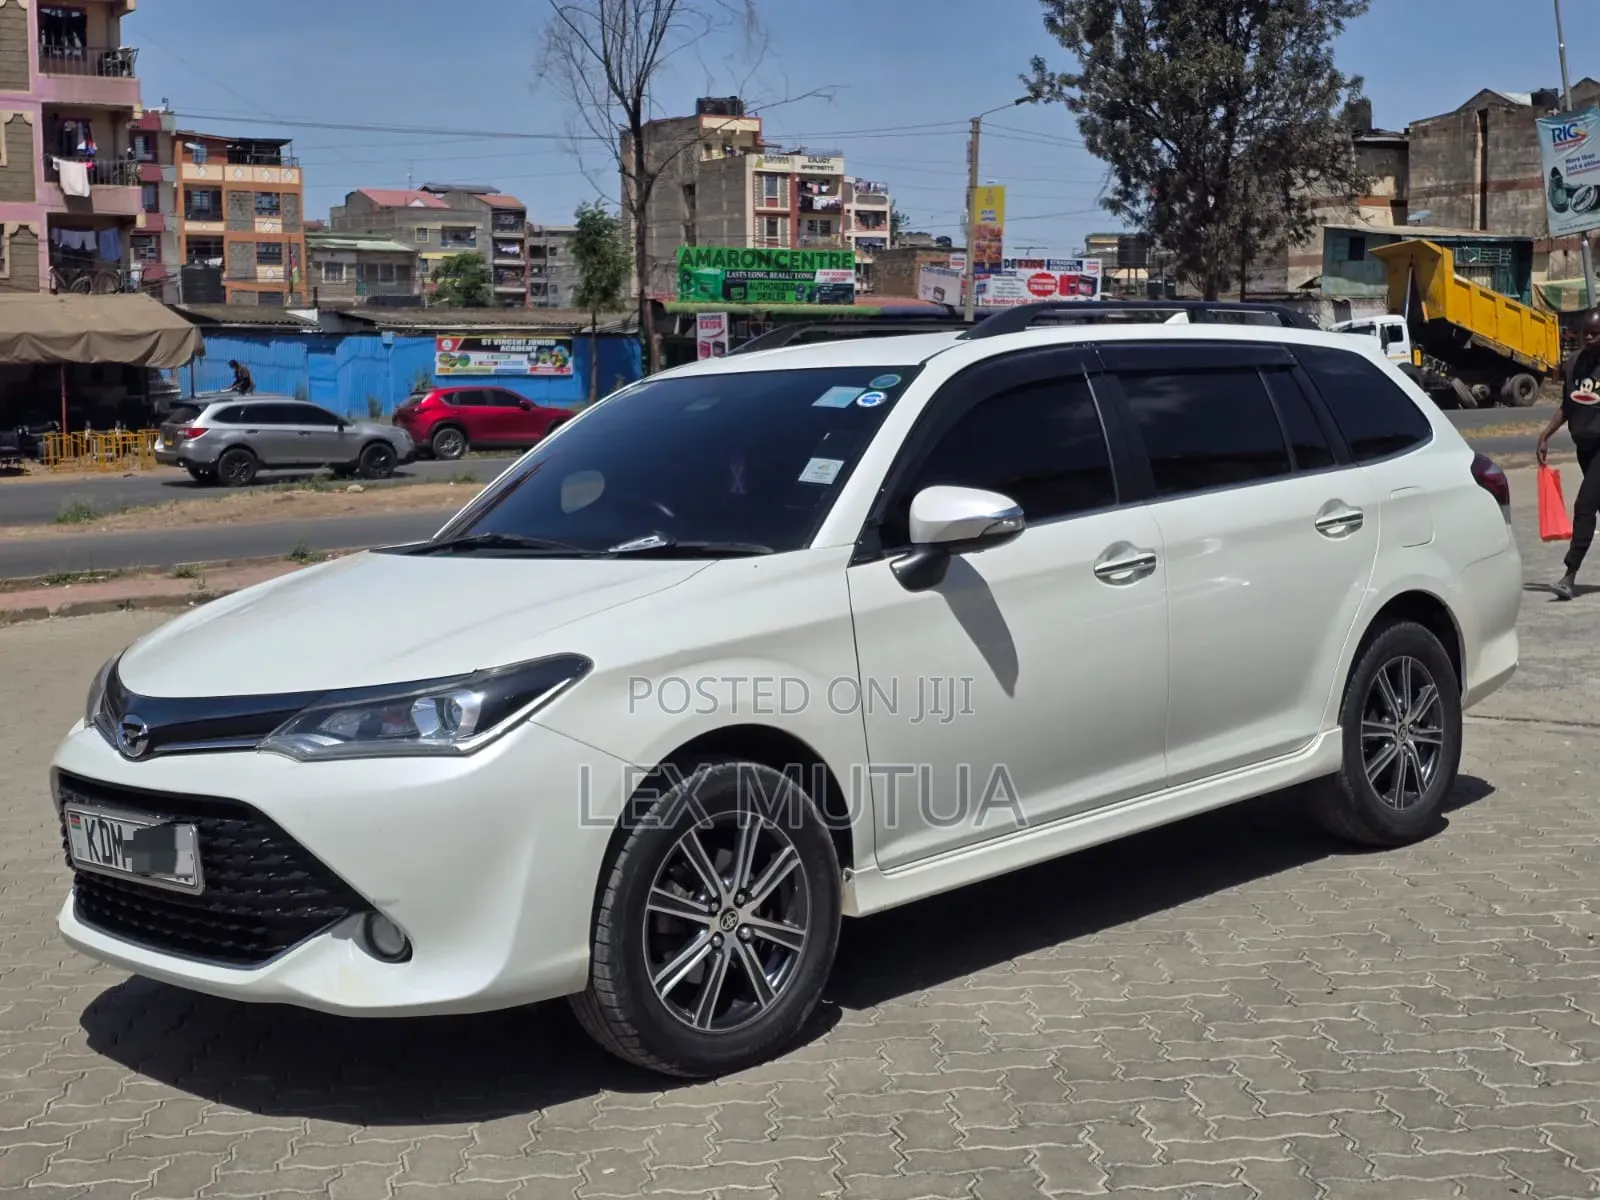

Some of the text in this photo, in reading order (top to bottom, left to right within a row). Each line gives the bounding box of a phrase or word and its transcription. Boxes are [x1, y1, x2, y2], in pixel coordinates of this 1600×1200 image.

[680, 249, 853, 270] AMARON CENTRE
[726, 270, 748, 280] LASTS
[748, 271, 769, 280] LONG,
[769, 271, 793, 280] REALLY
[793, 272, 814, 280] LONG
[757, 291, 786, 301] DEALER
[699, 320, 723, 329] EXIDE
